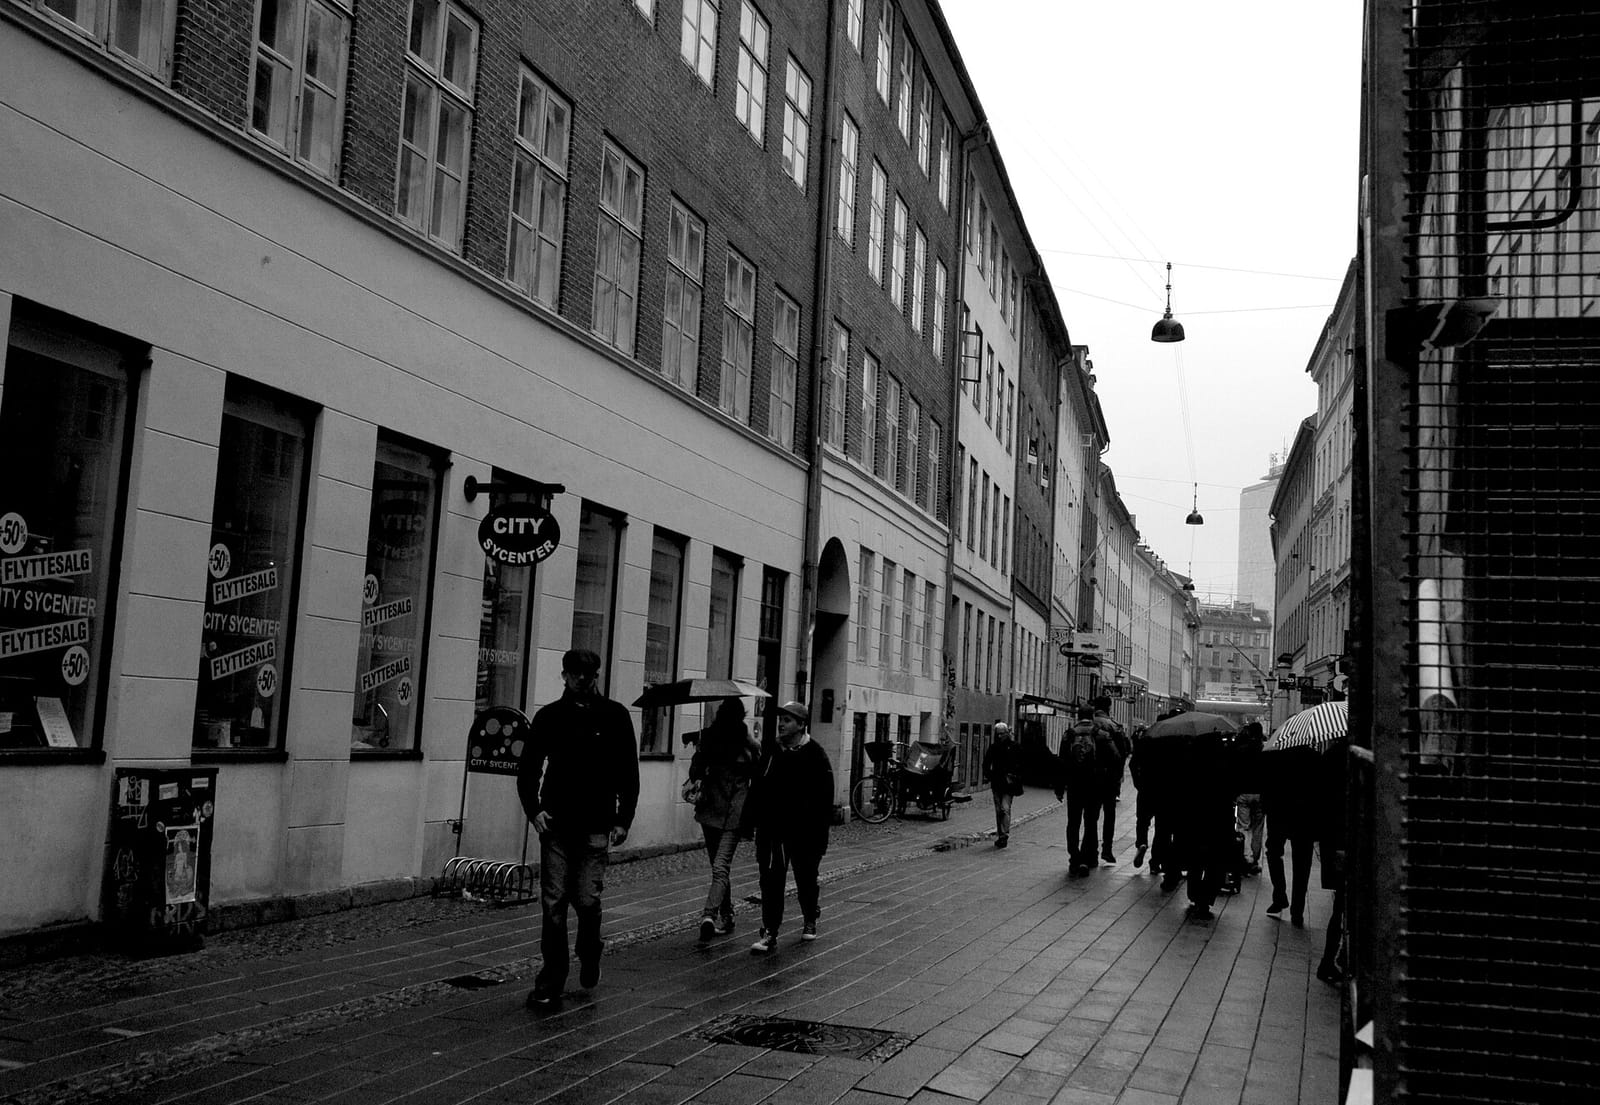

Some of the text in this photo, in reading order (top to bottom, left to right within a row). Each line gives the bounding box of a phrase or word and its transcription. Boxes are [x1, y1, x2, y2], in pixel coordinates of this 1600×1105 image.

[493, 517, 544, 535] CITY
[483, 538, 555, 564] SYCENTER
[4, 552, 89, 581] FLYTTESALG
[215, 571, 276, 602] FLYTTESALG
[24, 590, 97, 617] SYCENTER
[364, 599, 412, 626] FLYTTESALG
[1, 621, 87, 655] FLYTTESALG
[204, 612, 281, 637] CITY SYCENTER
[213, 641, 274, 677] FLYTTESALG
[362, 657, 410, 690] FLYTTESALG
[470, 758, 520, 771] CITY SYCENT
